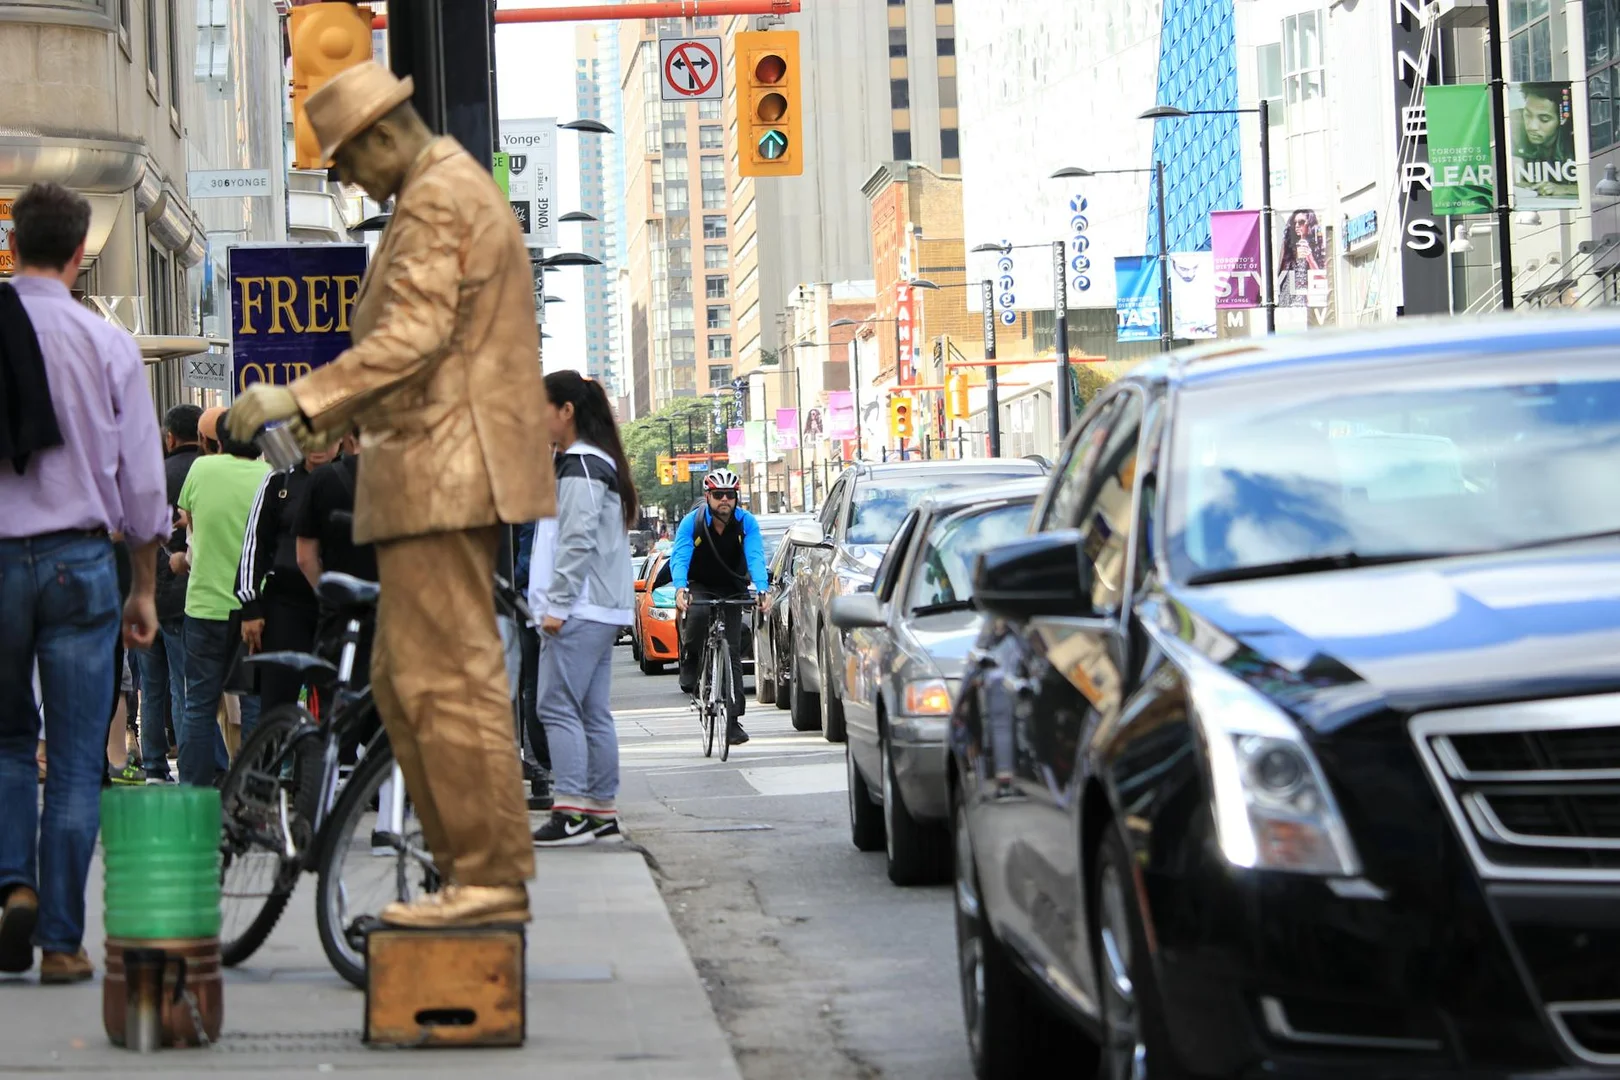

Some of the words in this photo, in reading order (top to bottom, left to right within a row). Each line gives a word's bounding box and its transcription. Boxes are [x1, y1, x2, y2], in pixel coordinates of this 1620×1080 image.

[503, 134, 541, 147] Yonge
[1432, 155, 1473, 163] DISTRICT
[210, 178, 267, 188] 306YONGE
[538, 197, 549, 230] YONGE
[1055, 246, 1065, 317] DOWNTOWN
[235, 275, 361, 334] FREE
[189, 361, 225, 377] XXI
